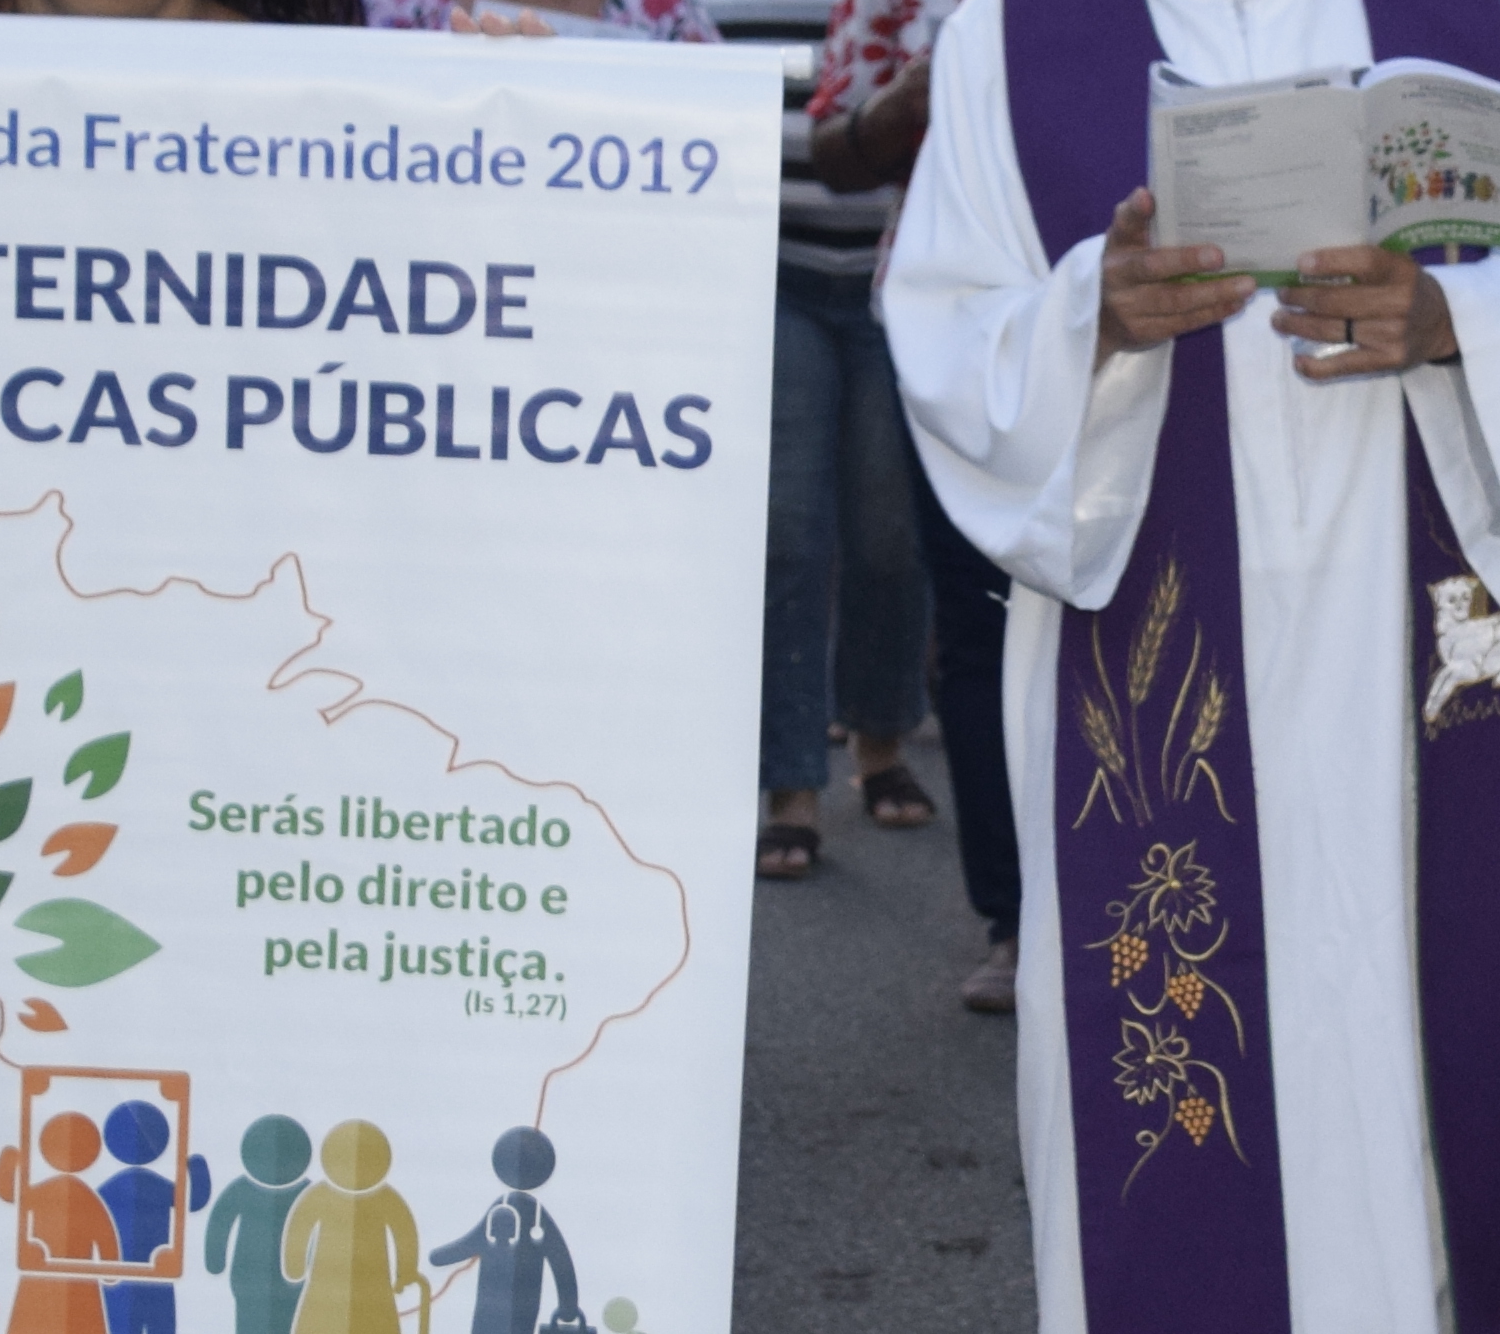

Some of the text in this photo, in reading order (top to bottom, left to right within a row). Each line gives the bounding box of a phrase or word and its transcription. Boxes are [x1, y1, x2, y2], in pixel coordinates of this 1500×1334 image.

[84, 113, 526, 187] Fraternidade
[546, 133, 718, 194] 2019
[226, 362, 713, 471] PÚBLICAS
[188, 789, 571, 848] Serás libertado
[236, 860, 568, 915] pelo direito e
[264, 928, 564, 988] pela justiça.
[464, 989, 568, 1022] (Is 1,27)
